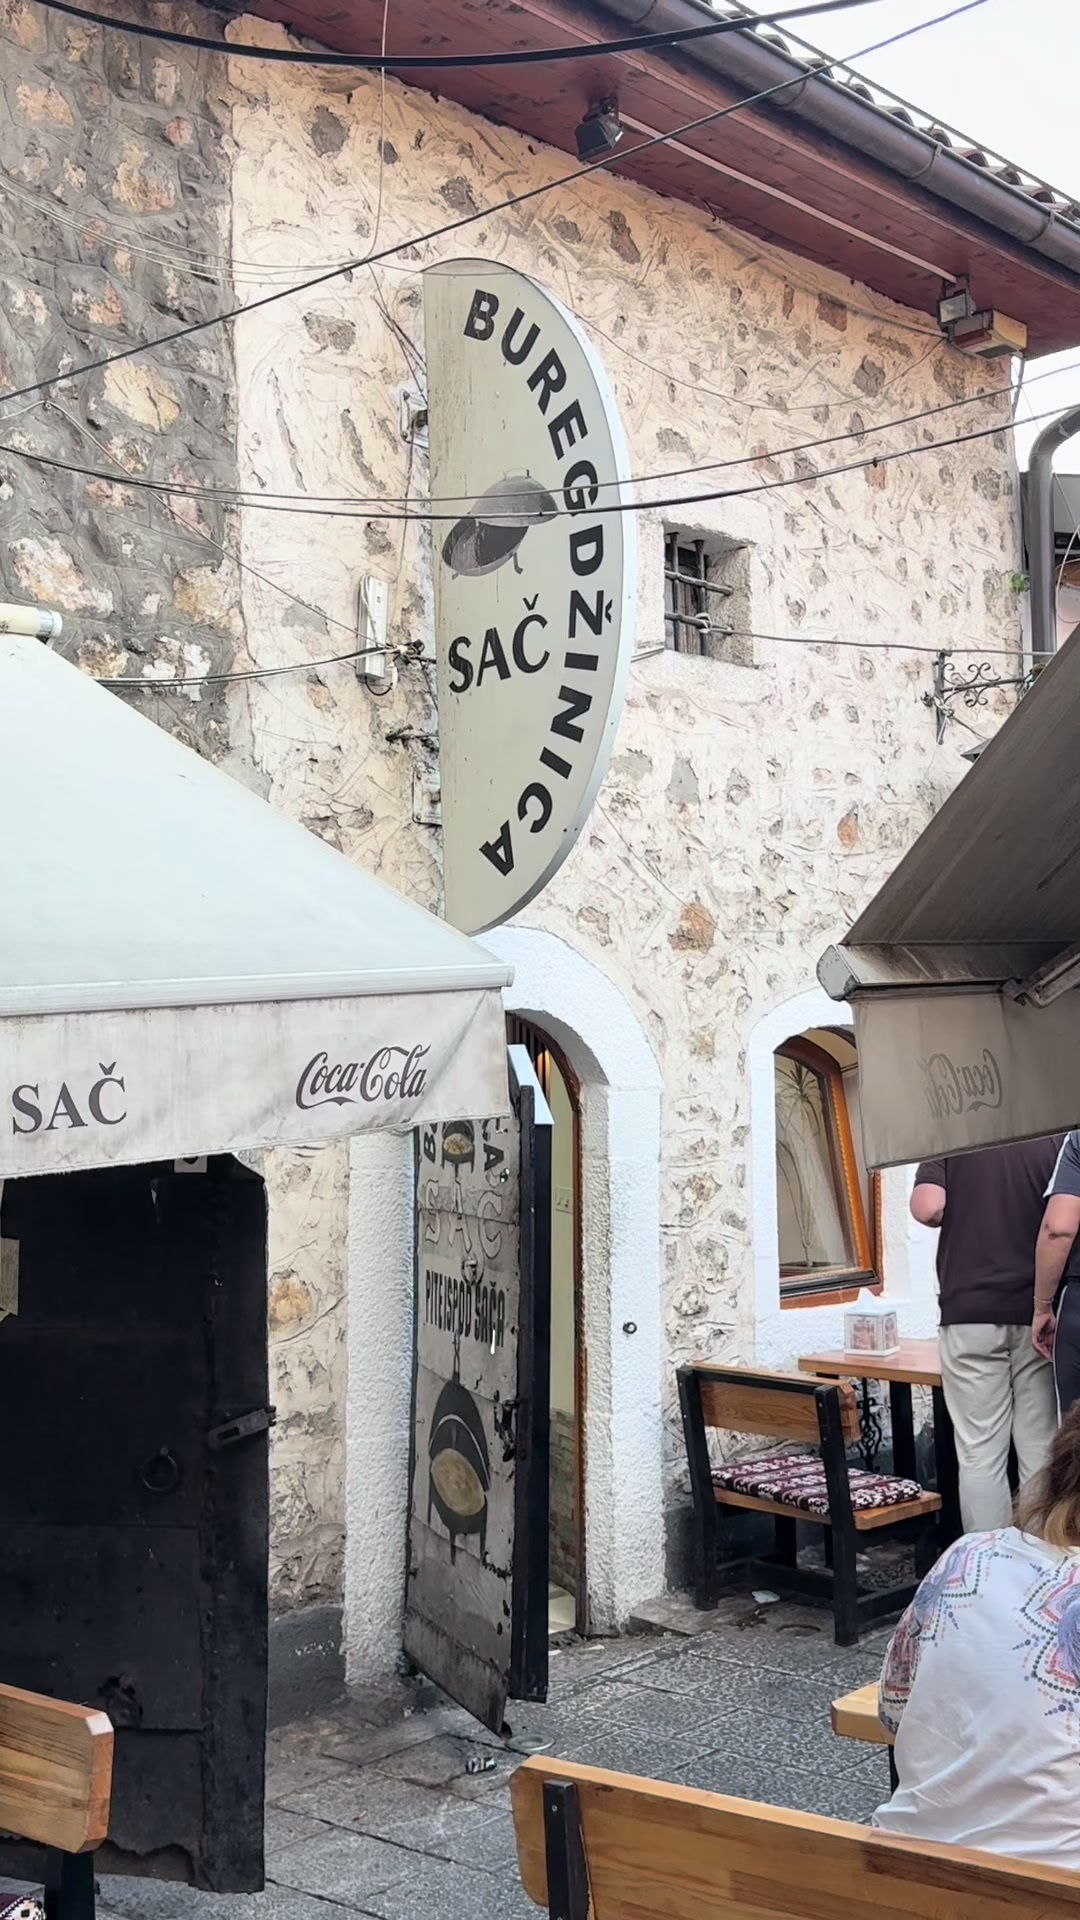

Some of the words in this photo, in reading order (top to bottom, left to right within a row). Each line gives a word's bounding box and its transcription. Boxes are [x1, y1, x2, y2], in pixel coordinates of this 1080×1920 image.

[463, 288, 613, 877] BUREGDŽINICA
[447, 593, 550, 695] SAČ
[11, 1061, 128, 1135] SAČ
[295, 1043, 431, 1109] Coca-Cola
